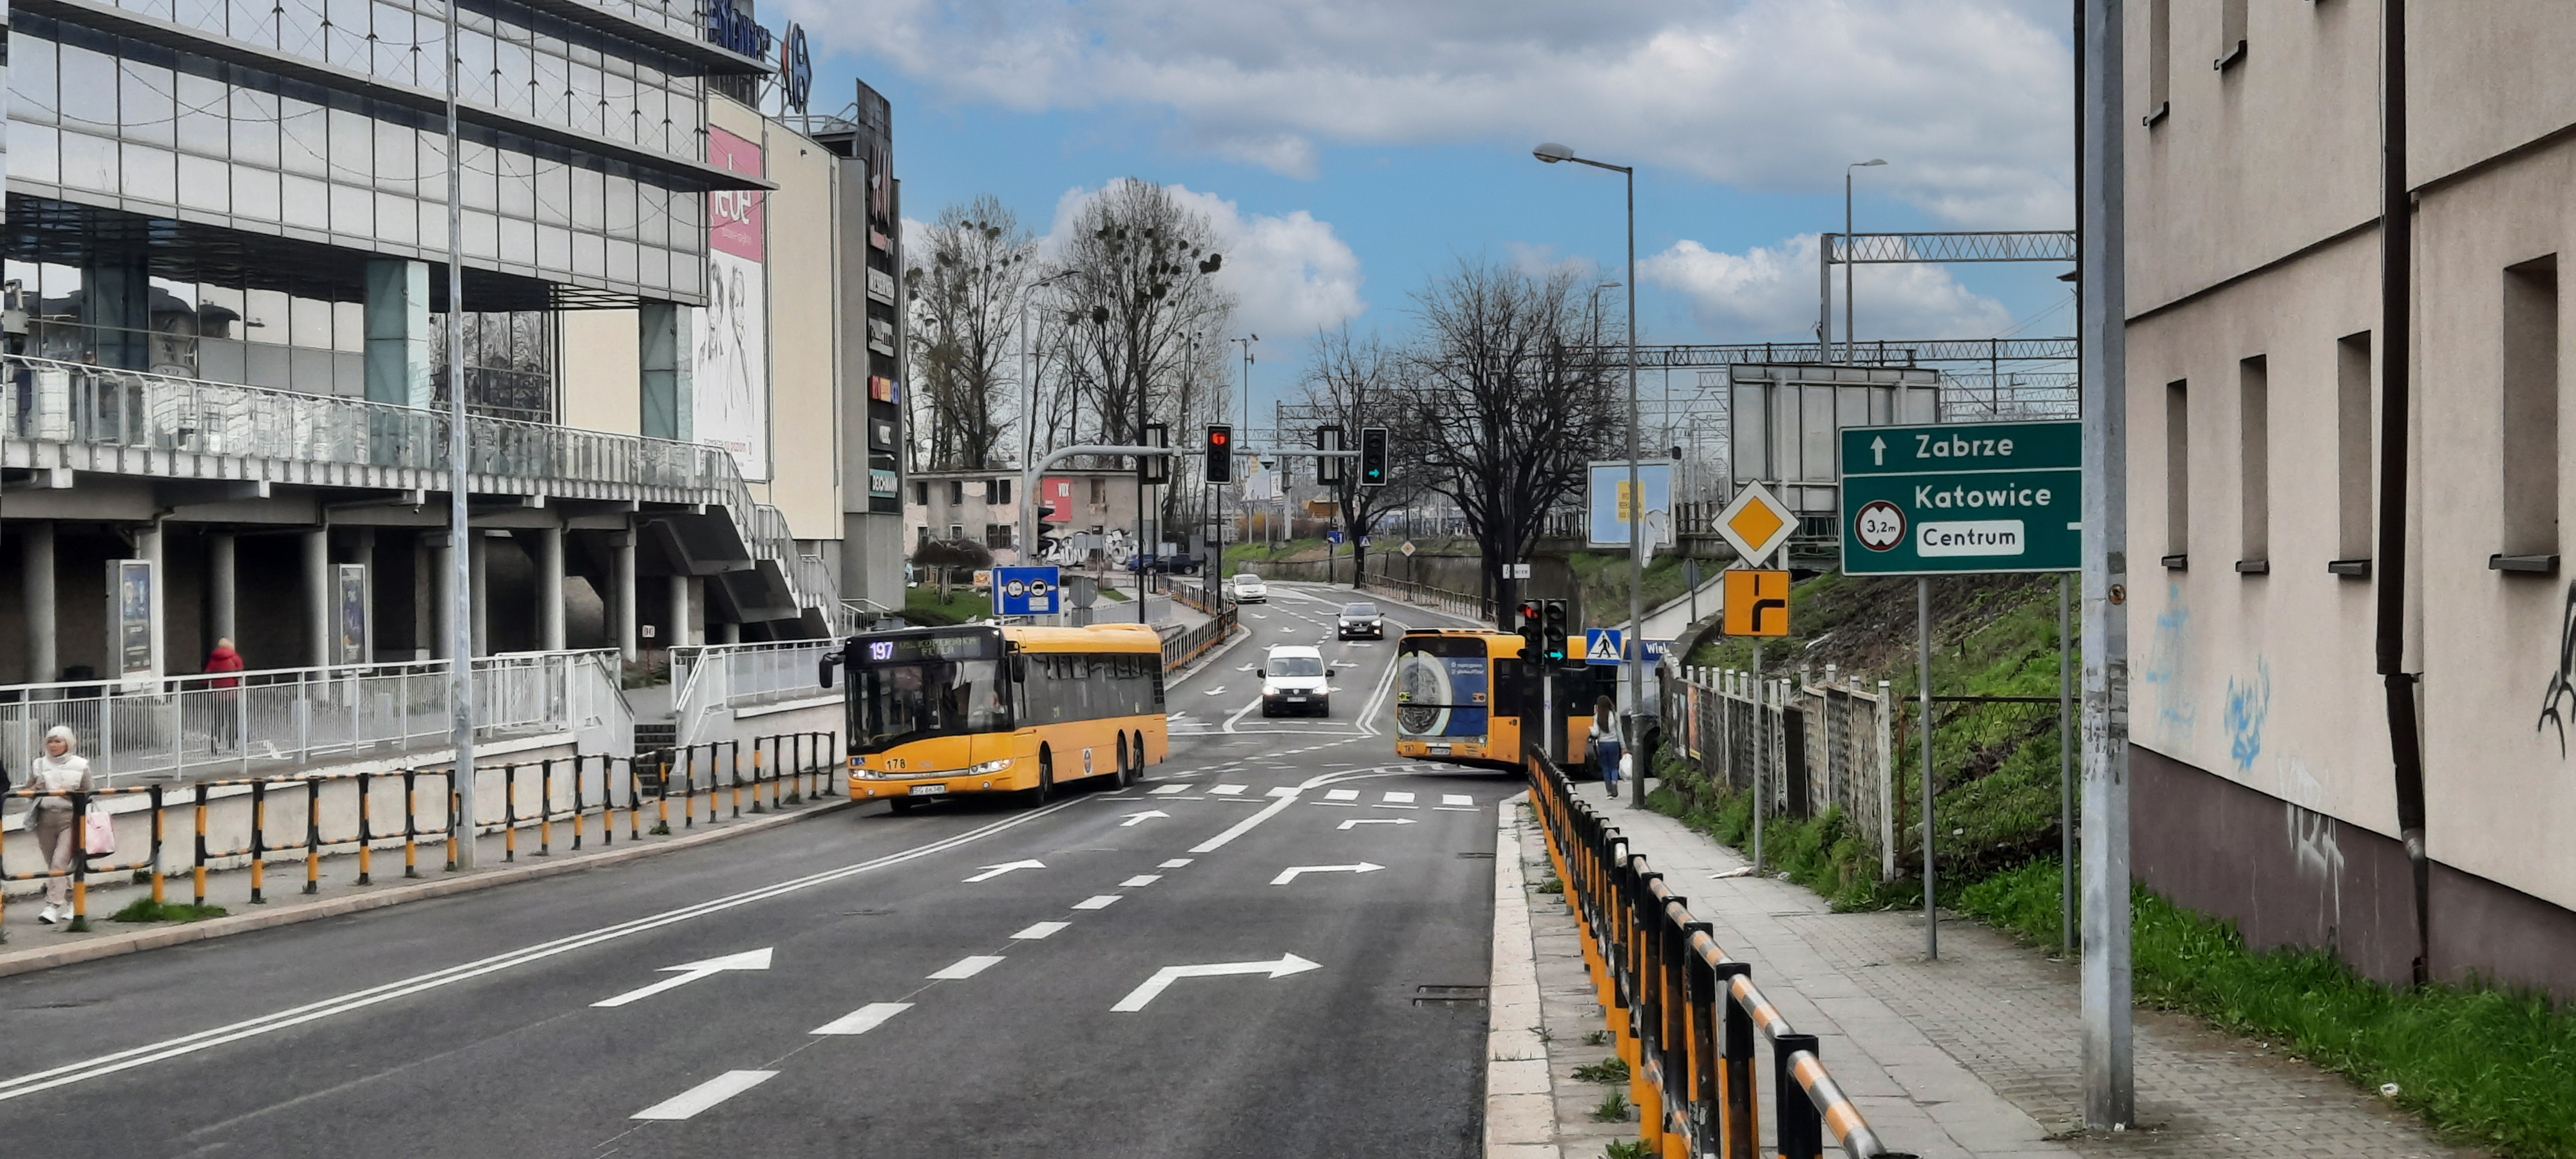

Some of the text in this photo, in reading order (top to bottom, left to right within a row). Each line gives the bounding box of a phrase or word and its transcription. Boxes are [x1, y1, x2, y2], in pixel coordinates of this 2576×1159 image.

[1915, 433, 2013, 458] Zabrze
[1915, 482, 2051, 509] Katowice
[1867, 520, 1896, 534] 3,2m
[1924, 528, 2016, 546] Centrum
[870, 641, 893, 660] 197
[887, 759, 905, 771] 178
